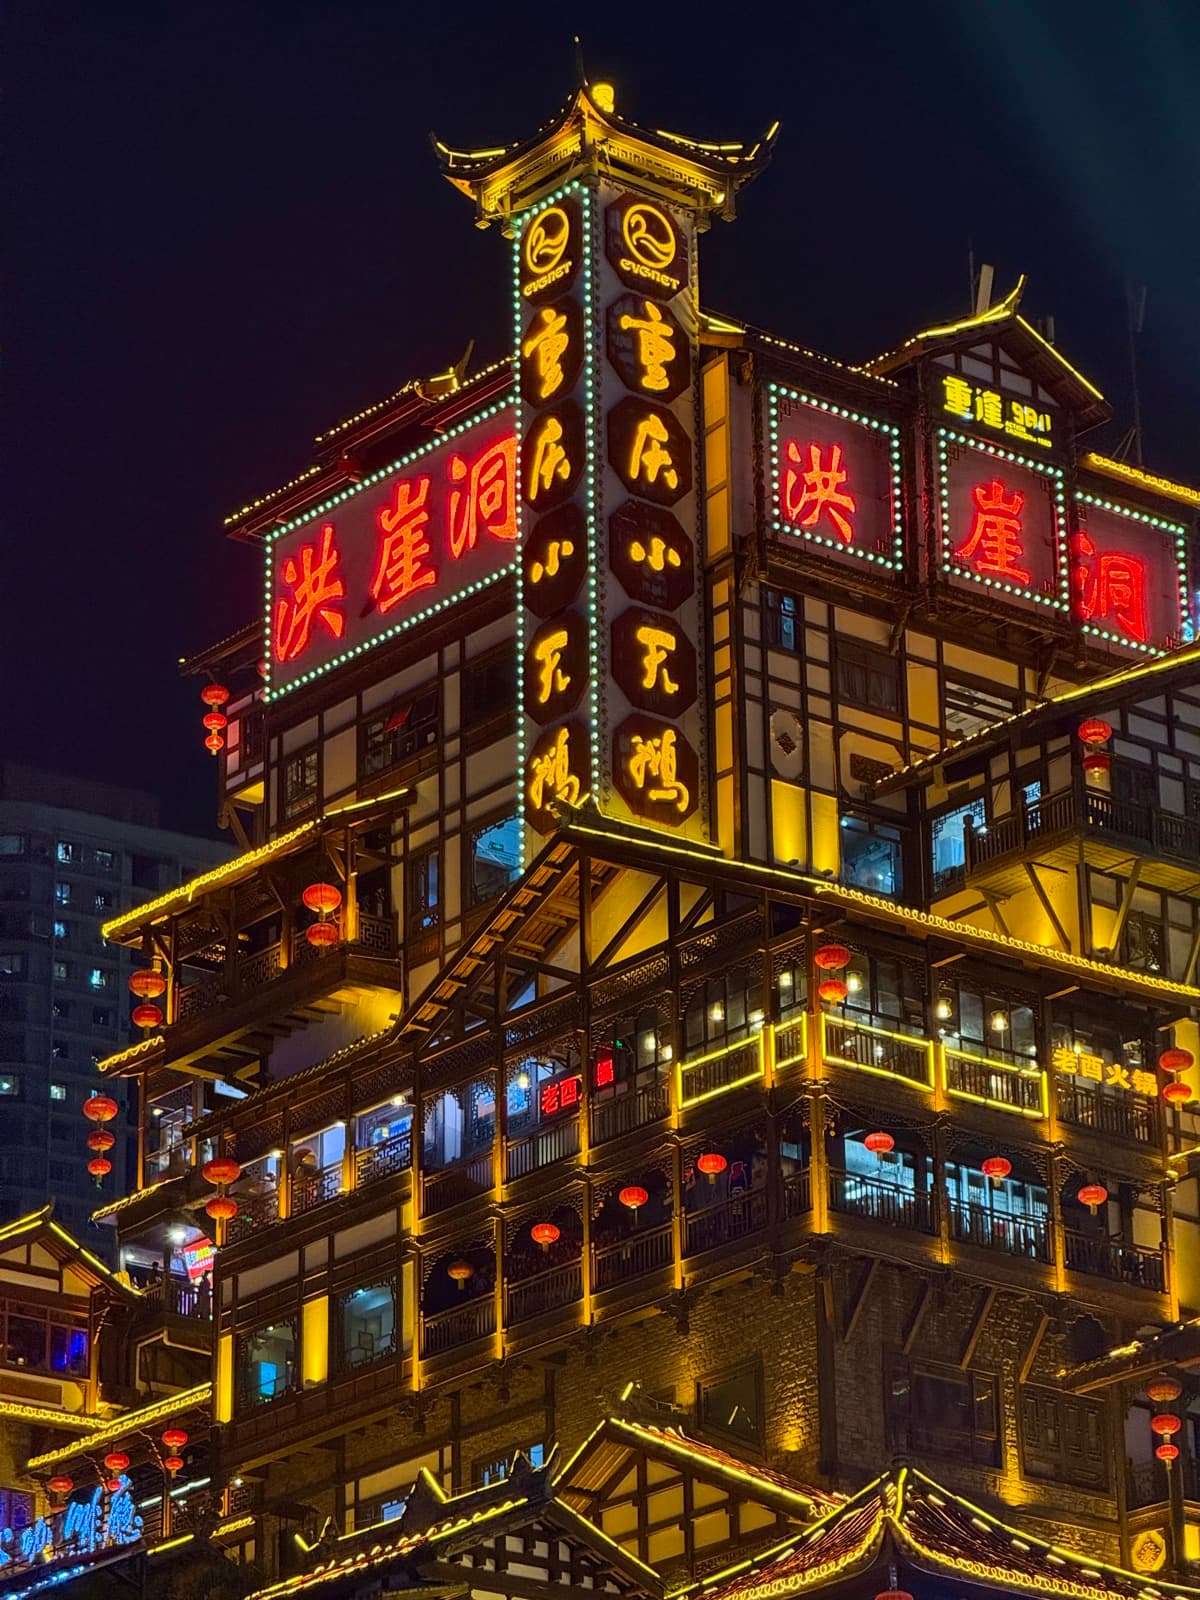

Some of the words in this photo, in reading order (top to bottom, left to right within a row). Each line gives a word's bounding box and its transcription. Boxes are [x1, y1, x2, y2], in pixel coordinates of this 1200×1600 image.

[942, 375, 1004, 429] 重逢
[274, 434, 519, 663] 洪崖洞
